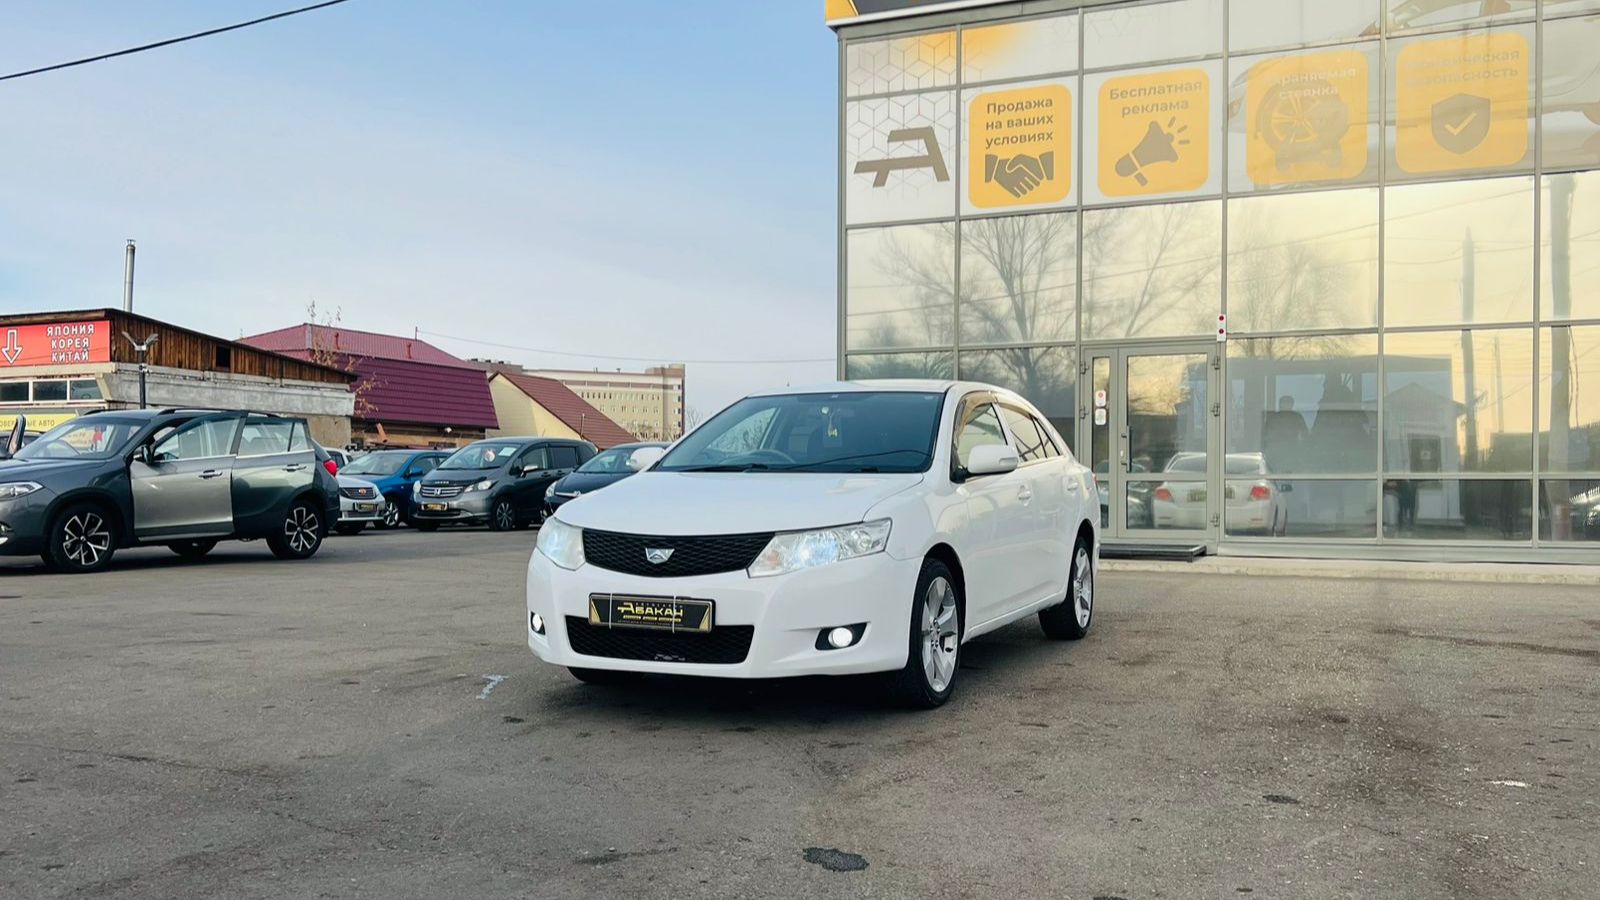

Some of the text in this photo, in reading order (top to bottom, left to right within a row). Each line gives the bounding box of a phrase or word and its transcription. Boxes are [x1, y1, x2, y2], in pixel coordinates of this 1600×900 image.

[1109, 81, 1201, 100] Бесплатная
[986, 98, 1053, 115] Продажа
[1121, 100, 1189, 118] реклама
[985, 115, 1053, 131] на ваших
[985, 131, 1053, 149] условиях
[47, 324, 94, 336] ЯПОНИЯ
[51, 338, 89, 349] КОРЕЯ
[51, 349, 89, 362] КИТАЙ
[38, 419, 55, 427] АВТО
[617, 601, 683, 617] АБАКАН
